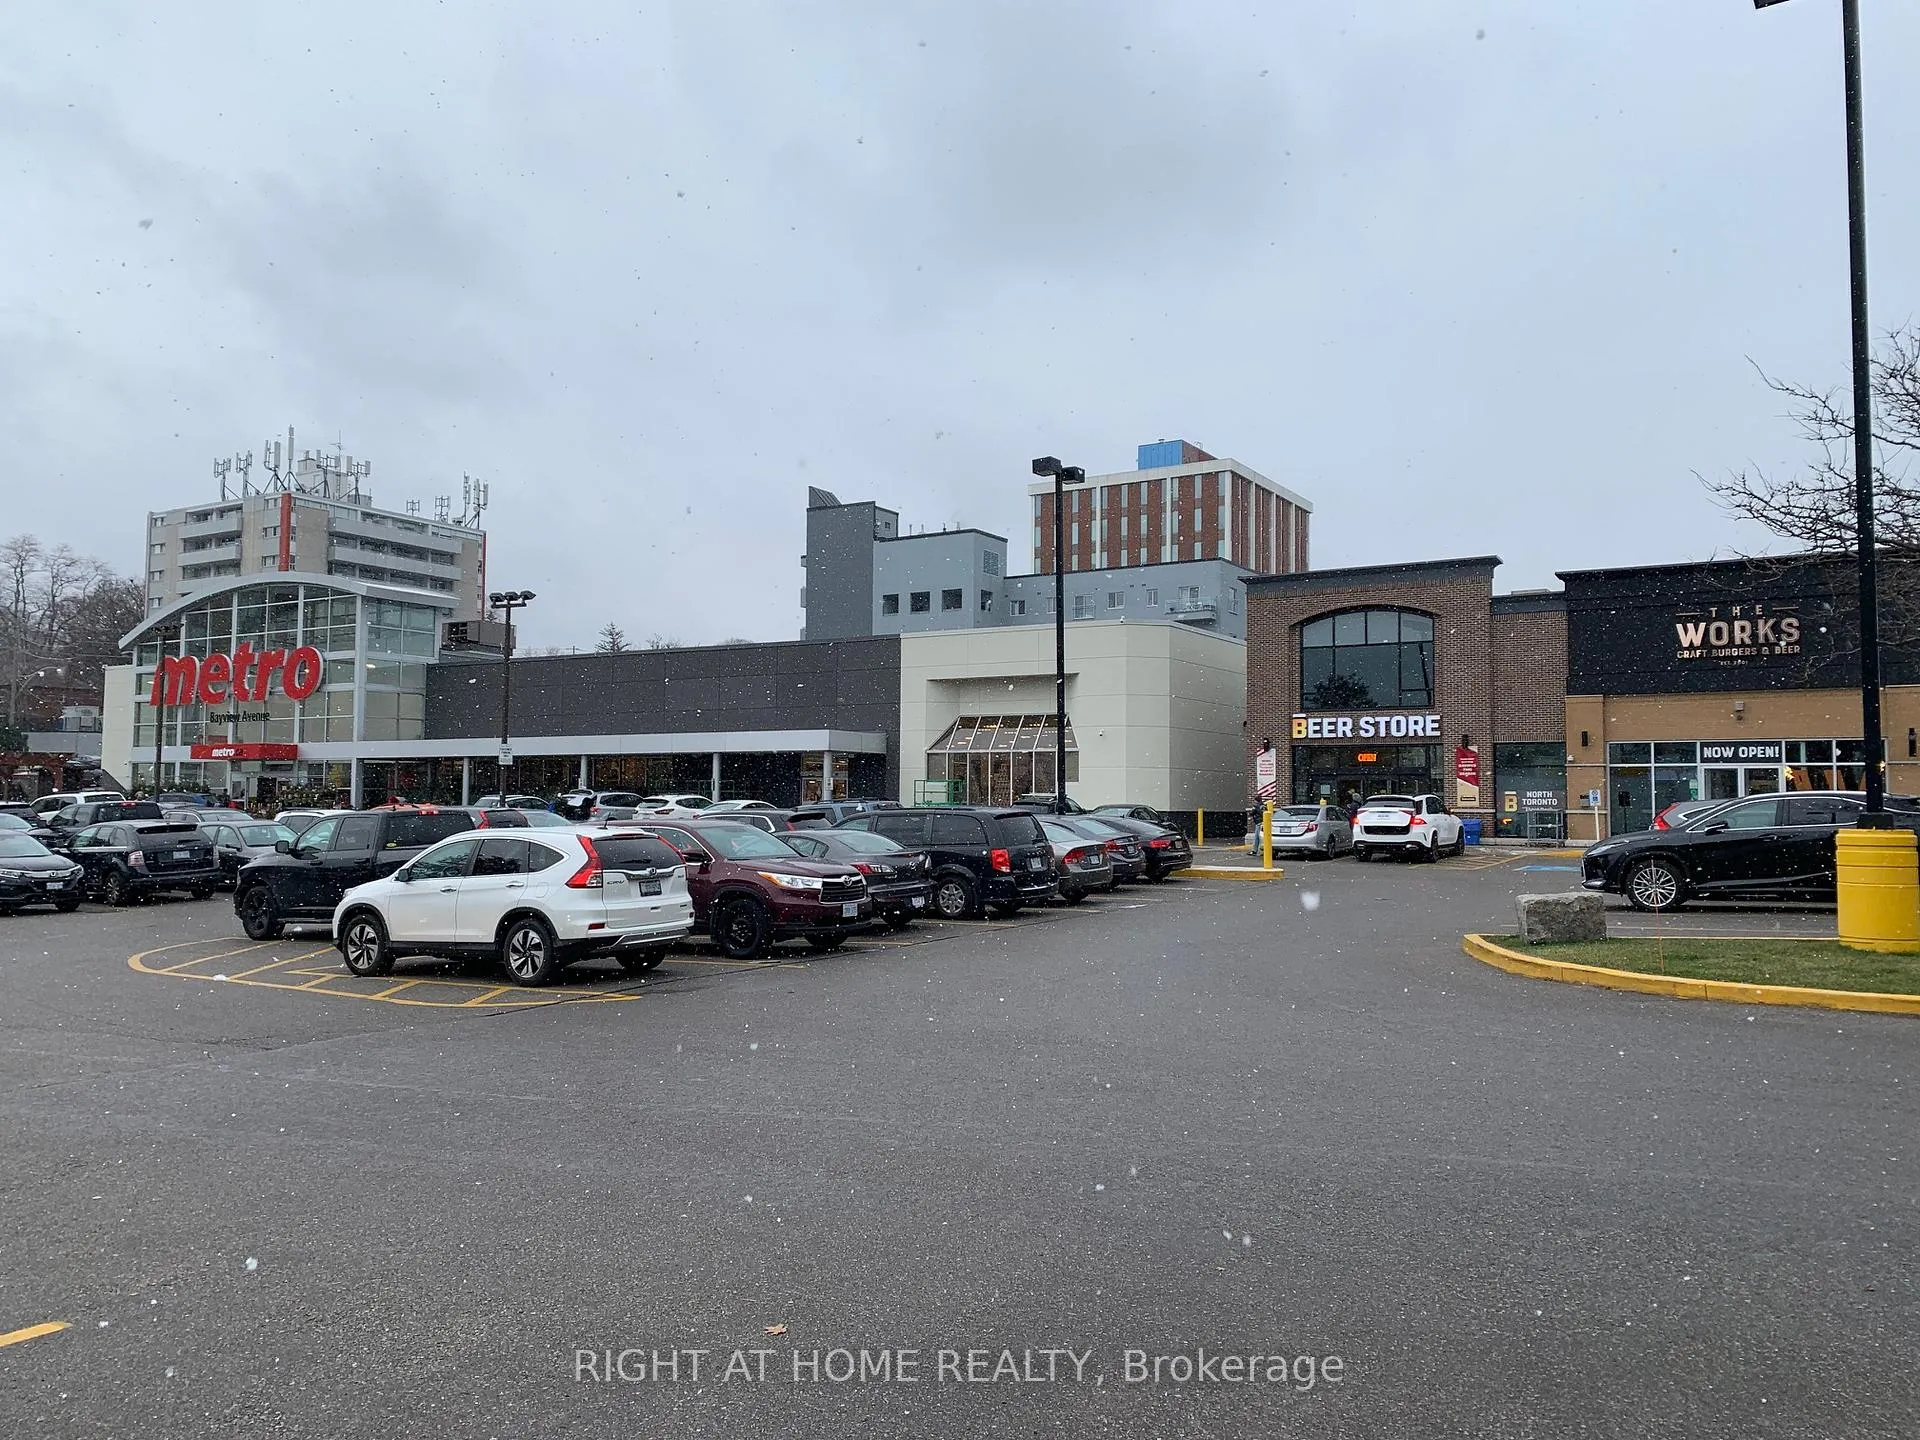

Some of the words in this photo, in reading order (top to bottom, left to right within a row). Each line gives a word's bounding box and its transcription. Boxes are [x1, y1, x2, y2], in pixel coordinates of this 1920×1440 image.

[1709, 604, 1763, 618] THE
[1676, 617, 1801, 647] WORKS
[1676, 650, 1708, 659] CRAFT
[1711, 647, 1758, 657] BURGERS
[1761, 647, 1770, 655] &
[1774, 645, 1801, 655] BEER
[150, 640, 324, 707] metro
[209, 711, 241, 726] Bayview
[242, 710, 271, 722] Avenue
[1292, 713, 1354, 739] BEER
[1359, 714, 1441, 738] STORE
[1357, 753, 1377, 762] OPEN
[1703, 746, 1735, 758] NOW
[1738, 746, 1780, 758] OPEN!
[1526, 790, 1553, 798] NORTH
[1521, 798, 1558, 806] TORONTO
